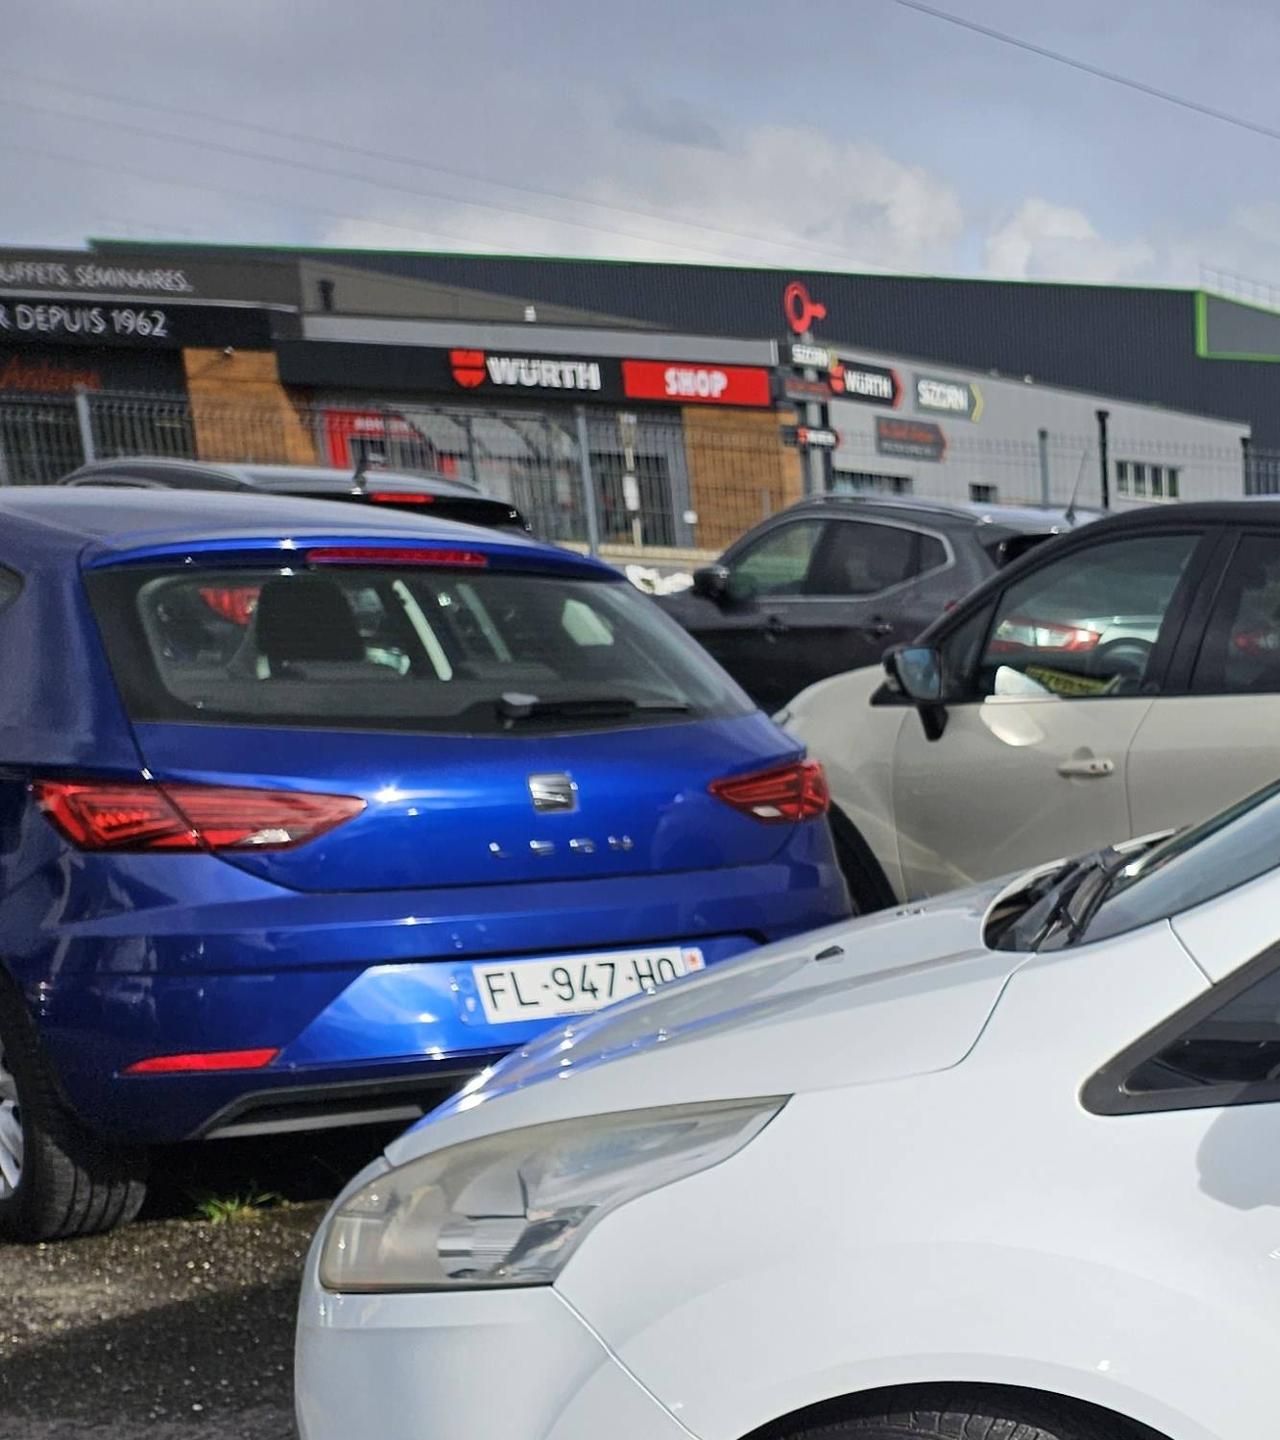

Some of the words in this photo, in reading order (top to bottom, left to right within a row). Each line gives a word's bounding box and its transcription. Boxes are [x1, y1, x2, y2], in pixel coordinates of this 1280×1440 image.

[15, 304, 106, 334] DEPUIS
[111, 308, 167, 337] 1962
[487, 357, 601, 390] WÜRTH
[665, 368, 728, 397] SHOP
